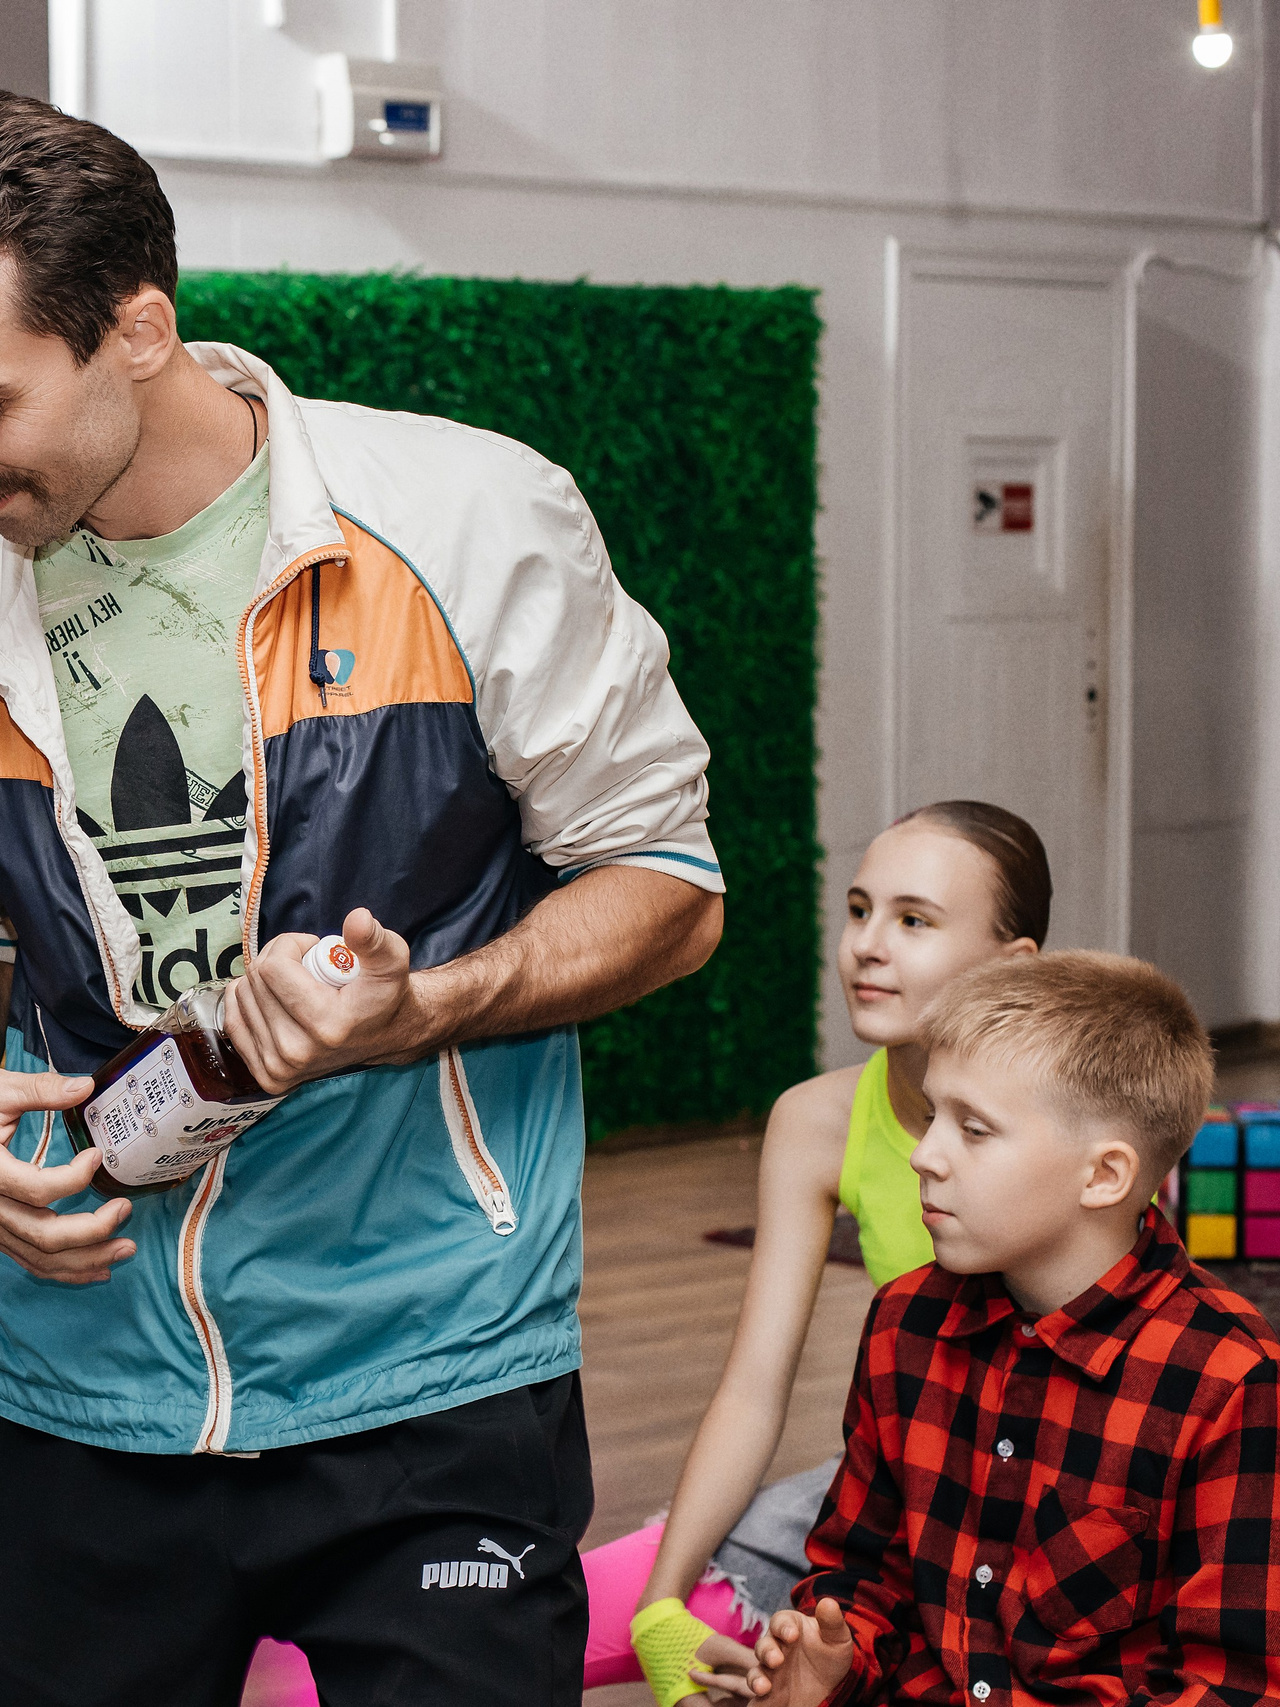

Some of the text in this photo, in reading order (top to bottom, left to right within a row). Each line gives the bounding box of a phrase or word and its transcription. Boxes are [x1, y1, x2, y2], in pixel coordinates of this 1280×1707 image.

[44, 592, 123, 656] HEY THER
[143, 1080, 161, 1114] FAMILY
[150, 1078, 165, 1105] BEAM
[164, 1068, 178, 1095] SEVEN
[104, 1113, 121, 1147] RECIPE
[110, 1108, 128, 1141] FAMILY
[122, 1098, 139, 1132] DISTILLING
[230, 1110, 268, 1123] BEA
[154, 1145, 228, 1165] BOURBO
[421, 1561, 509, 1590] PUMA
